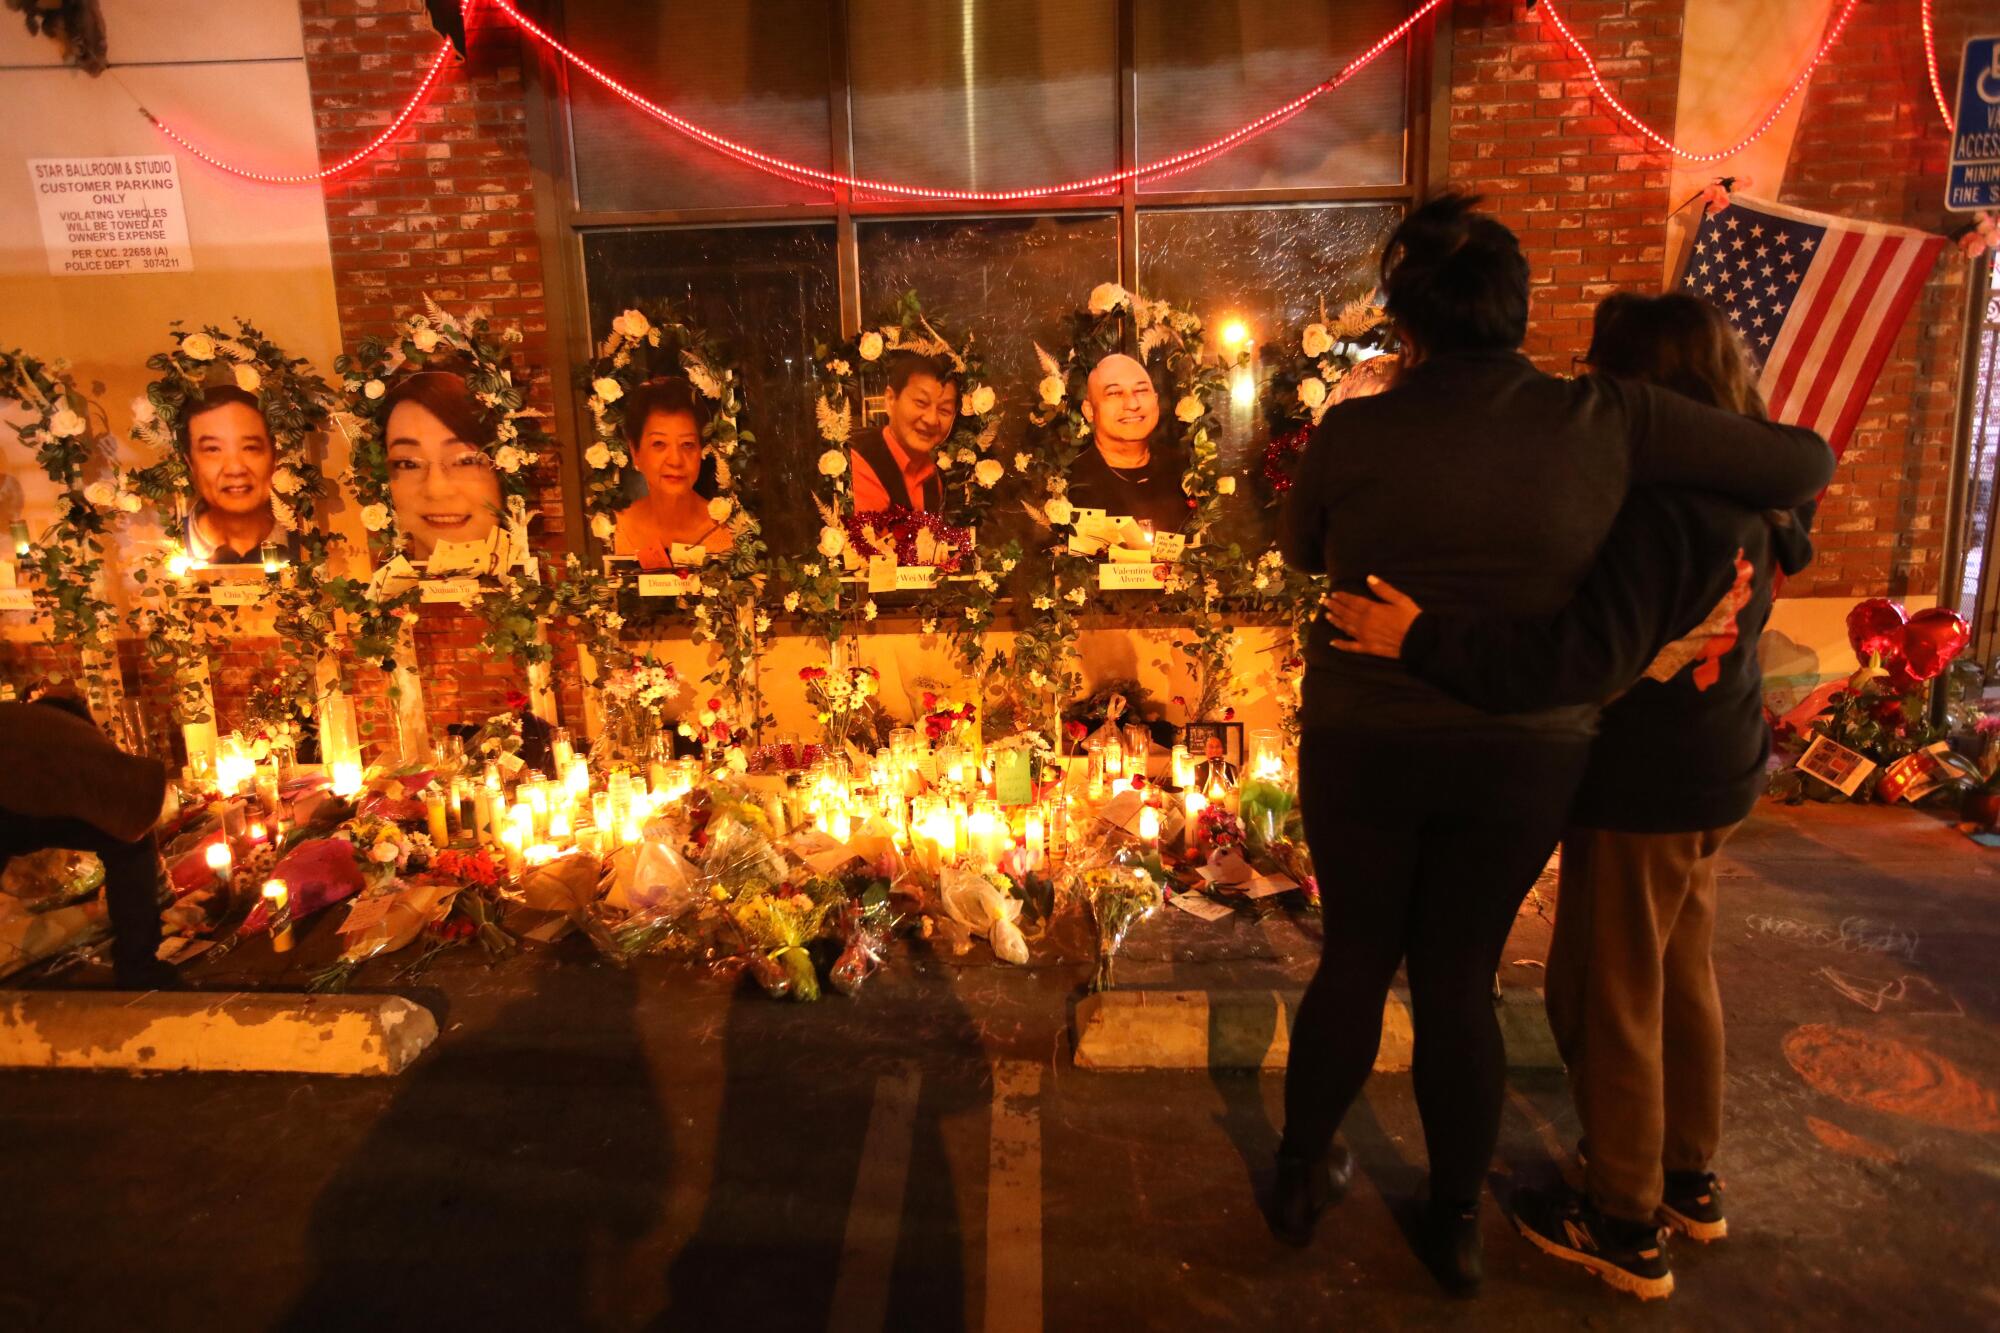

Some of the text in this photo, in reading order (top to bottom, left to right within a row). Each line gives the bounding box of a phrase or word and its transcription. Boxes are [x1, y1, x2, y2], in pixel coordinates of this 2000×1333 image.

[1957, 131, 2000, 159] ACCES
[35, 160, 171, 178] STAR BALLROOM & STUDIO
[40, 179, 173, 193] CUSTOMER PARKING
[92, 194, 126, 204] ONLY
[1952, 186, 1980, 204] FINE
[59, 208, 167, 221] VIOLATING VEHICLES
[66, 219, 164, 232] WILL BE TOWED AT
[68, 230, 166, 242] OWNER'S EXPENSE
[72, 249, 92, 258] PER
[122, 247, 151, 257] 22658
[154, 245, 168, 258] (A)
[64, 261, 102, 271] POLICE
[1112, 567, 1151, 575] Valentino
[648, 579, 672, 587] Diana
[900, 573, 917, 582] Wei
[1120, 575, 1145, 583] Alvero
